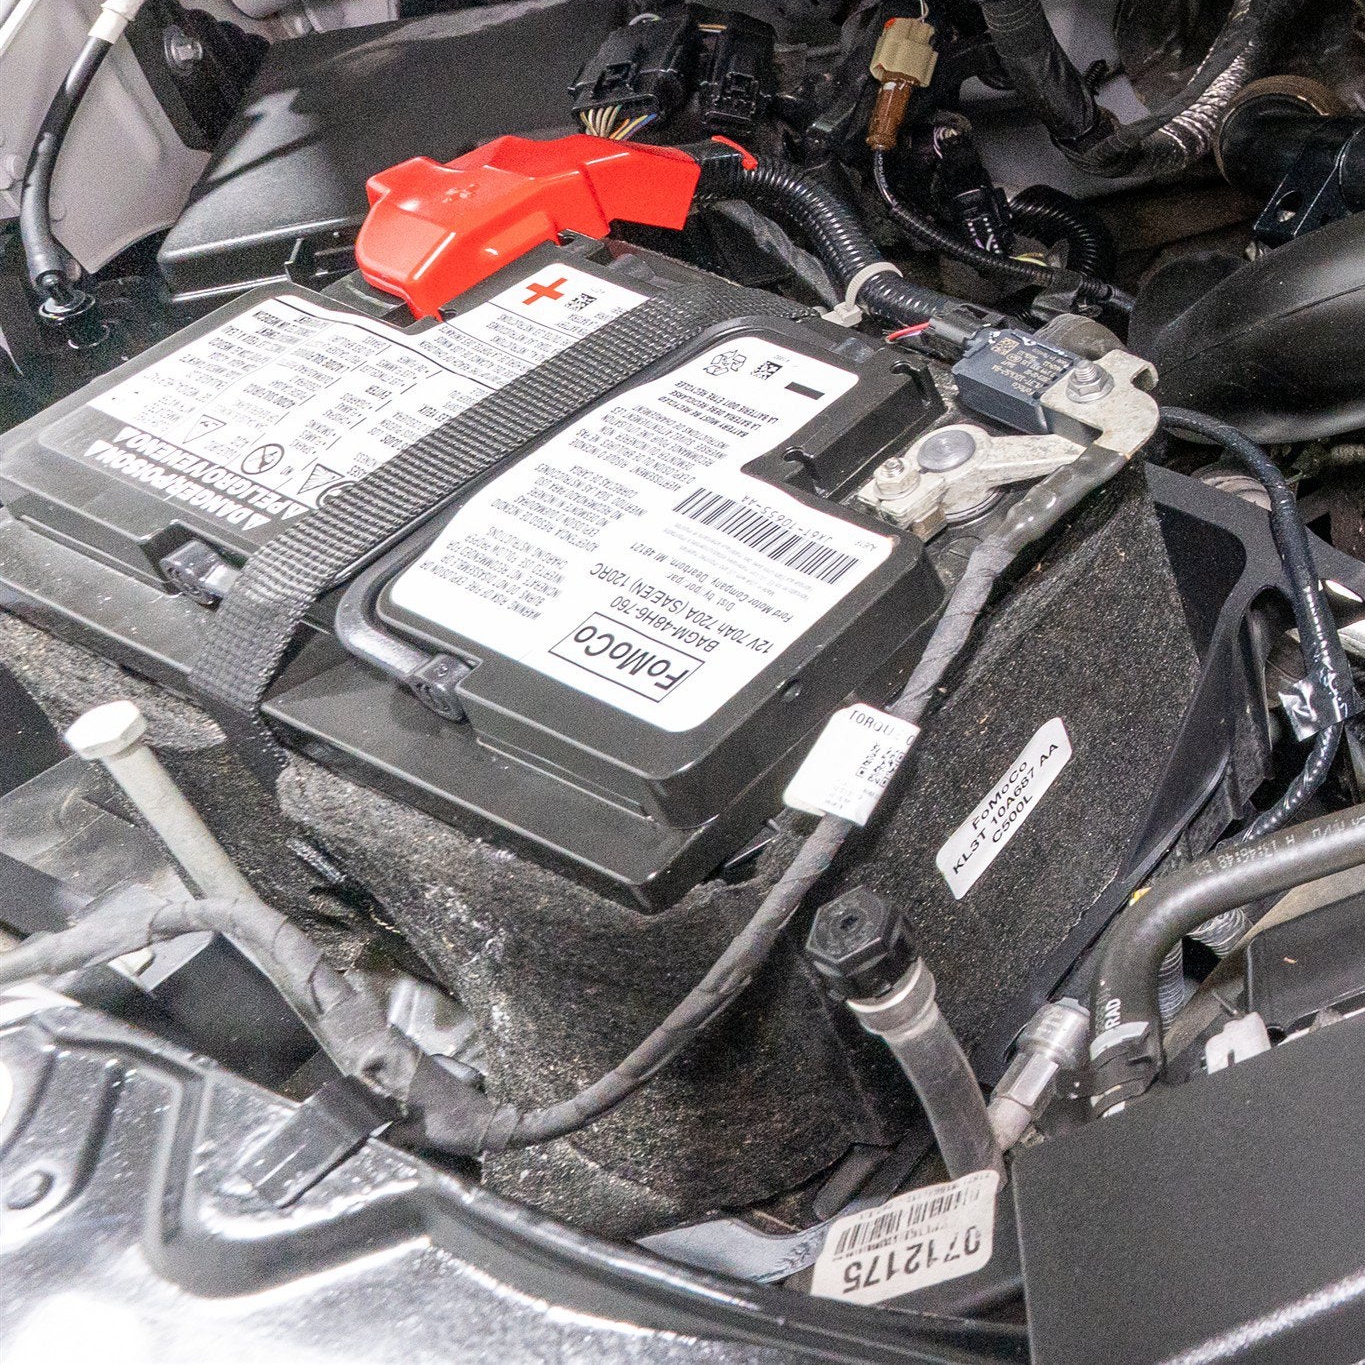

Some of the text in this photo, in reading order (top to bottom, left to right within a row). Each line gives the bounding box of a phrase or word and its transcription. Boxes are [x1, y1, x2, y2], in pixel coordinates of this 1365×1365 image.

[656, 394, 749, 438] BATTERY MUST BE RECYCLED
[735, 494, 836, 545] JX6T-10655-AA
[628, 540, 657, 558] 48121
[652, 551, 669, 563] MI
[586, 561, 776, 655] 12V 70Ah 720A (SAE/EN) 120RC
[606, 594, 721, 653] BAGM-48H6-760
[744, 596, 775, 614] Motor
[770, 608, 794, 622] Ford
[564, 623, 690, 691] FoMoCo
[951, 740, 1061, 877] KL3T 10A687 AA
[970, 759, 1029, 833] FoMoCo
[989, 793, 1034, 846] C500L
[1105, 998, 1121, 1029] RAD
[842, 1223, 983, 1296] 0712175
